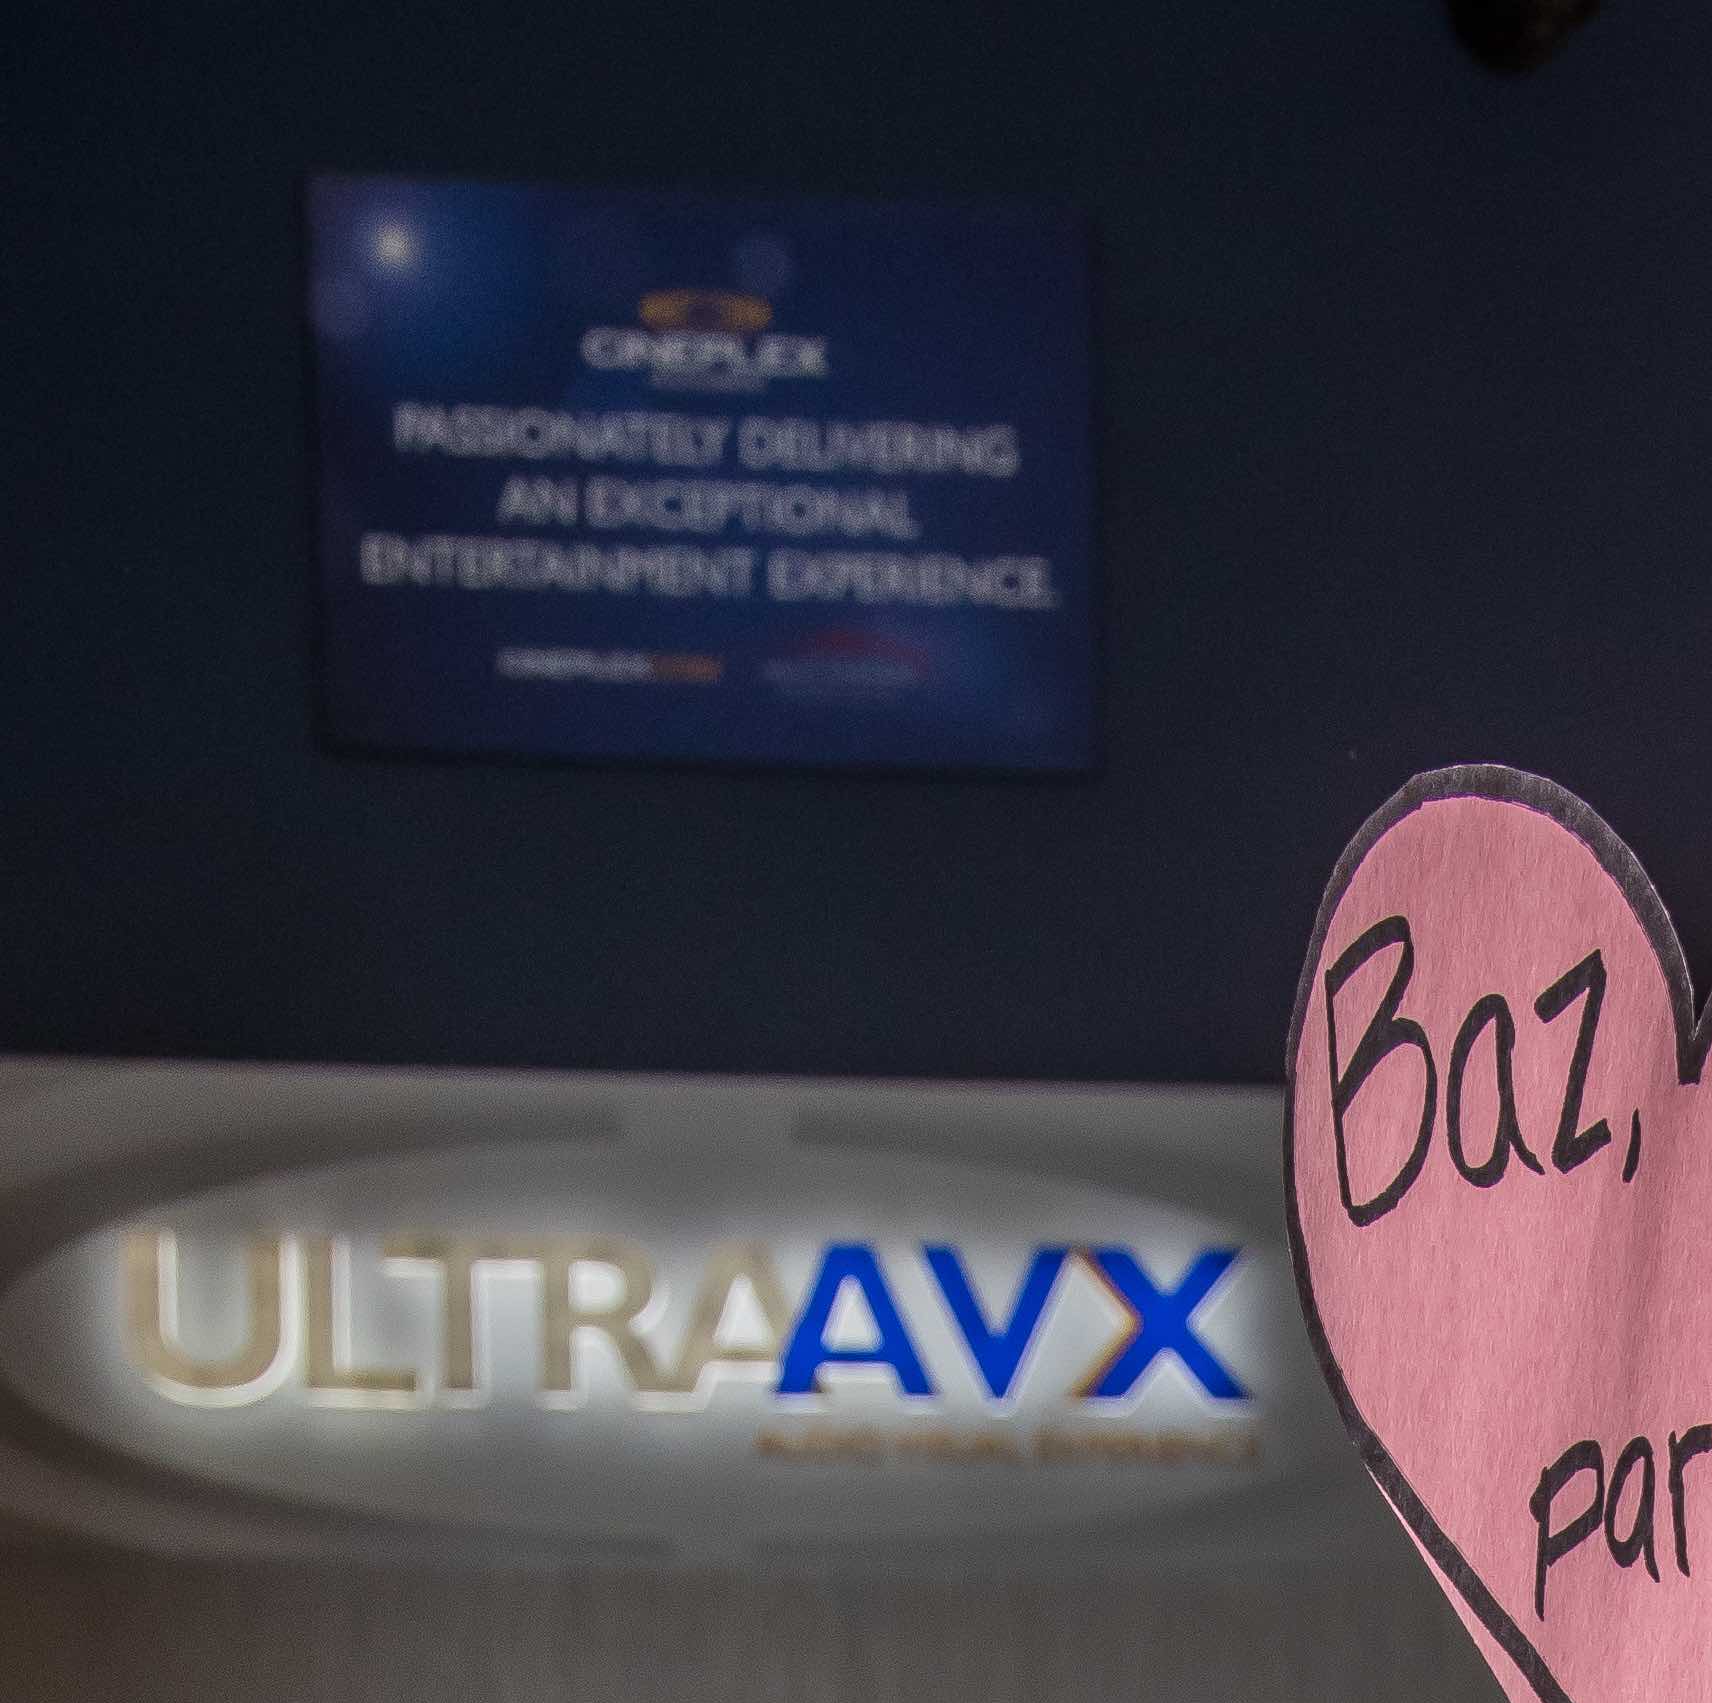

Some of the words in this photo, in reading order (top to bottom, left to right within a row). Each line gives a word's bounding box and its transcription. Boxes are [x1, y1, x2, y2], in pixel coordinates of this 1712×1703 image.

[580, 327, 830, 378] CINEPLEX
[393, 402, 730, 466] PASSIONATELY
[737, 416, 1021, 478] DELIVERING
[498, 477, 578, 525] AN
[585, 479, 920, 538] EXCEPTIONAL
[360, 531, 755, 595] ENTERTAINMENT
[1324, 915, 1641, 1228] Baz,
